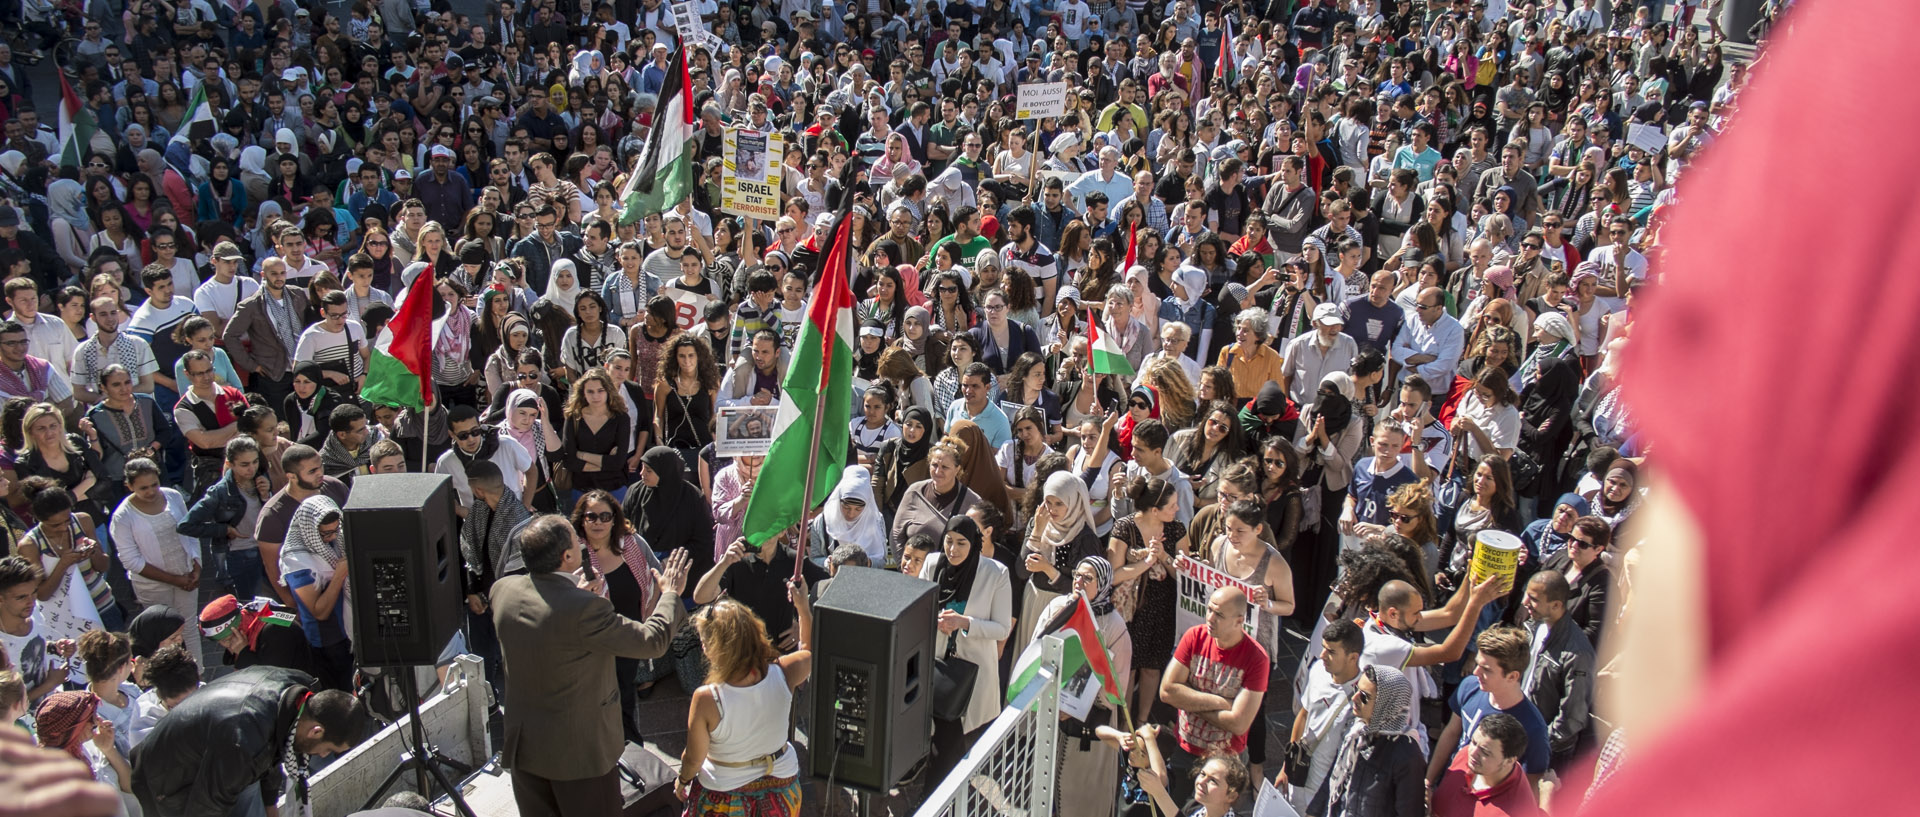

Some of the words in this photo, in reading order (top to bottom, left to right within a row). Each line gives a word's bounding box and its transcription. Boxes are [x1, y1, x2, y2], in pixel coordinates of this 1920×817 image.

[1042, 88, 1063, 97] AUSSI
[1030, 99, 1060, 107] BOYCOTTE
[1031, 108, 1050, 116] ISRAEL
[738, 181, 773, 196] ISRAEL
[746, 195, 763, 204] ETAT
[733, 202, 777, 215] TERRORISTE
[1290, 294, 1305, 334] PALESTIN
[1363, 498, 1377, 519] 19
